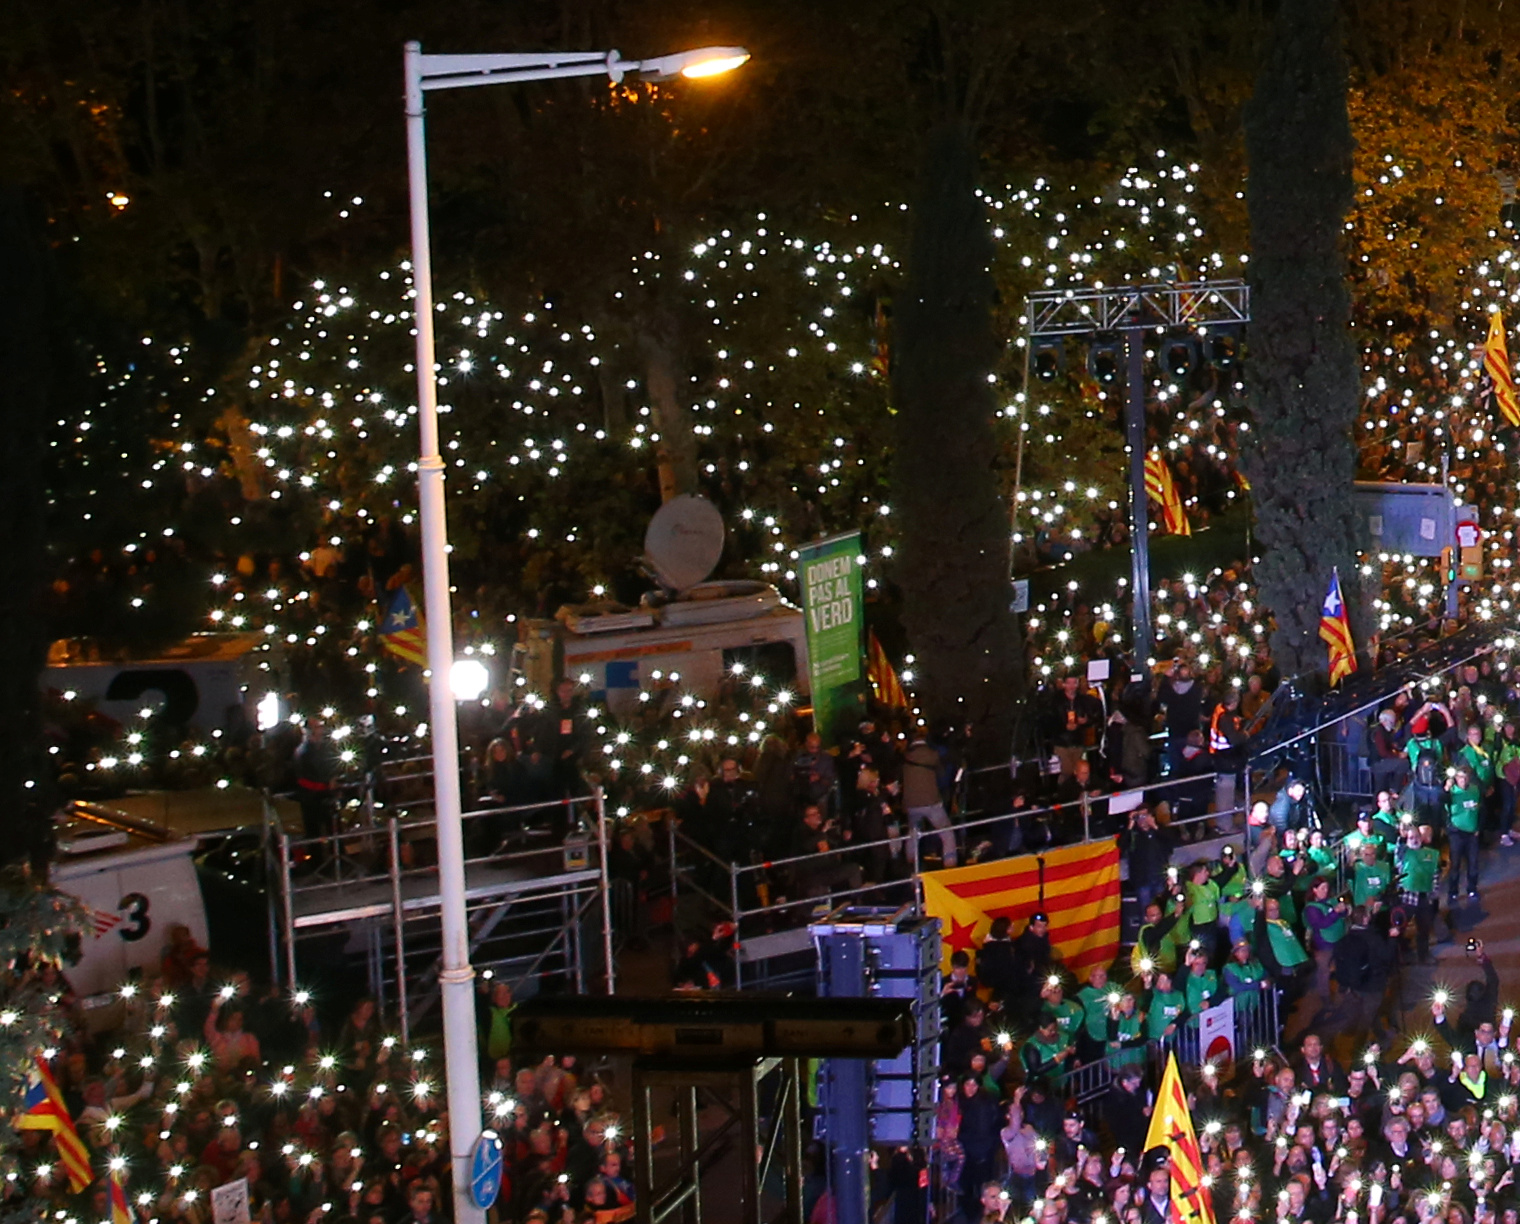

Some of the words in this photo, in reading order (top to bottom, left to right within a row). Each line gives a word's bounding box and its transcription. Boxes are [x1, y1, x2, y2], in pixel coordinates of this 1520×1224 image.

[807, 555, 852, 586] DONEM
[809, 580, 833, 607] PAS
[835, 576, 852, 599] AL
[811, 597, 853, 633] VERD
[117, 892, 151, 942] 3
